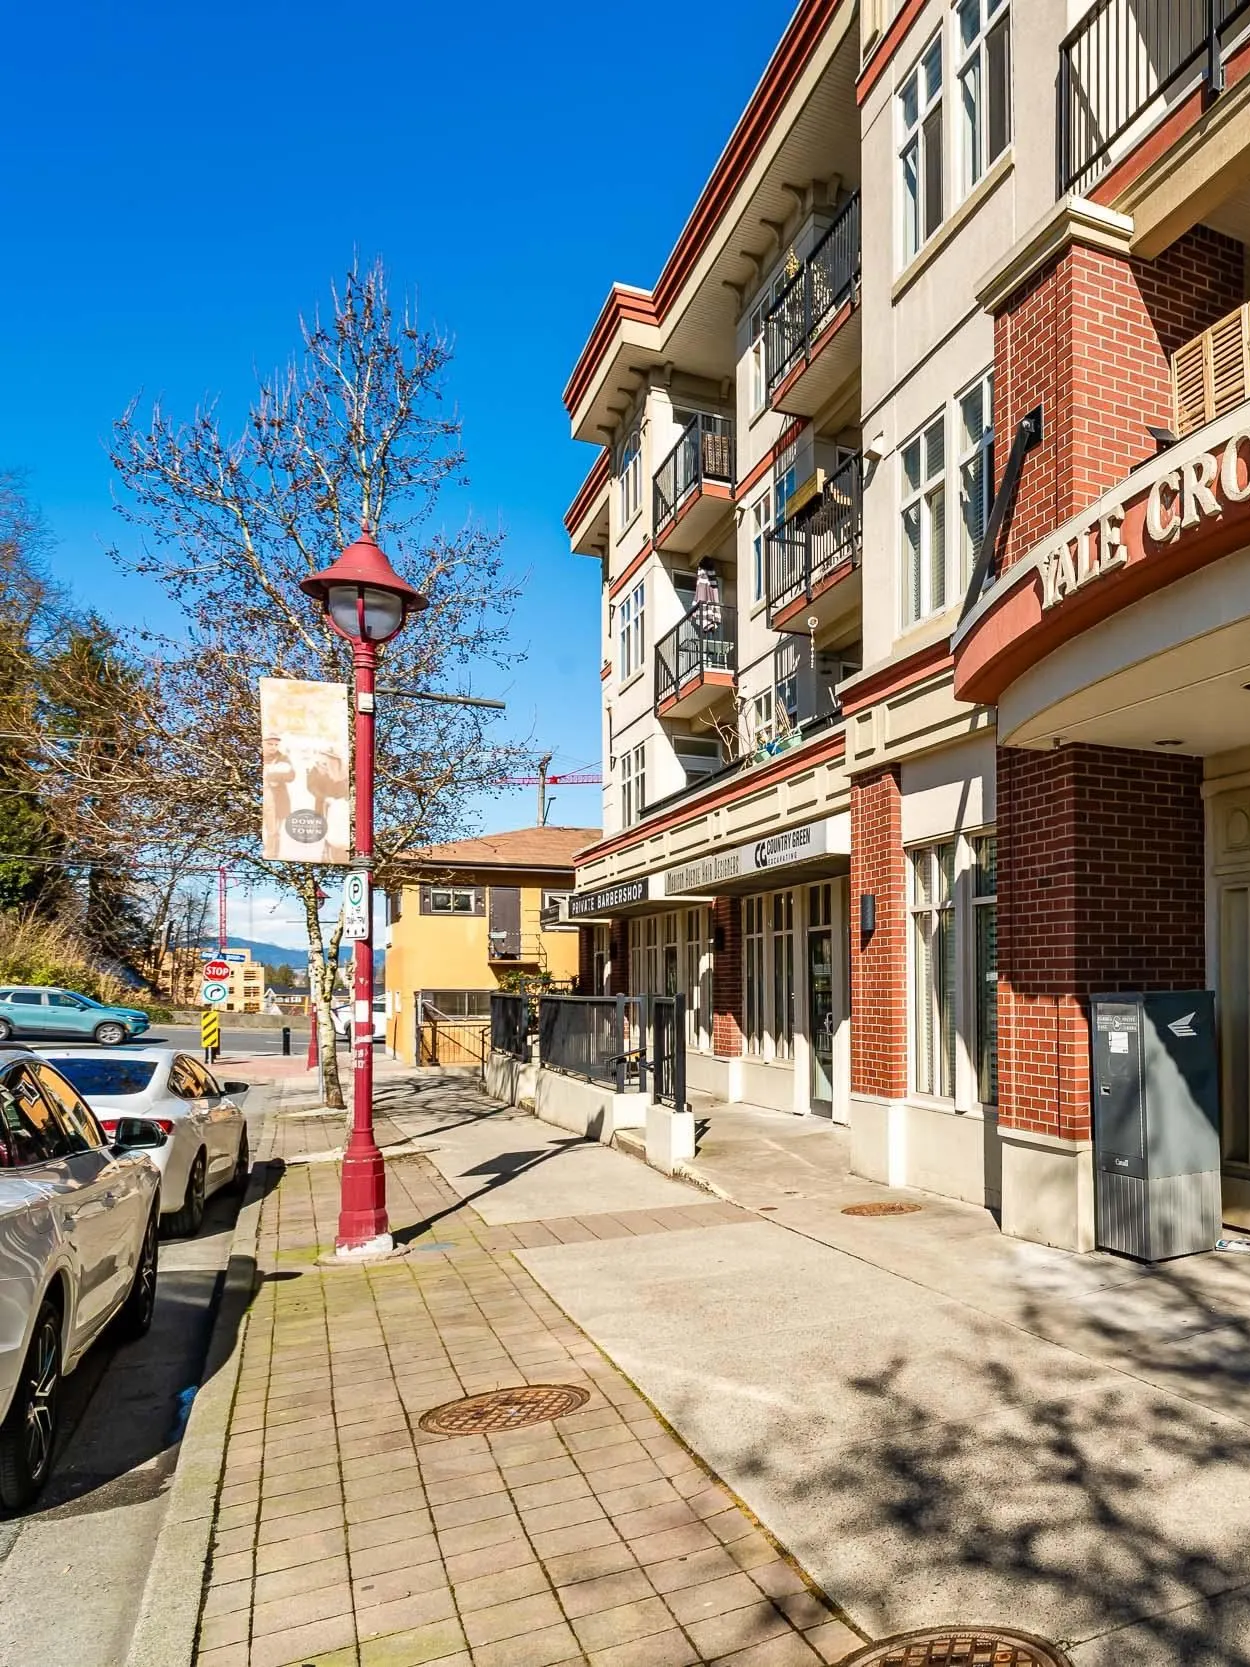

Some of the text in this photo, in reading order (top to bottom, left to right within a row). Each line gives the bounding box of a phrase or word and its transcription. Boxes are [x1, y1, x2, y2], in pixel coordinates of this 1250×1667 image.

[1035, 504, 1128, 611] YALE
[754, 841, 768, 868] CG
[766, 827, 811, 855] COUNTRY GREEN
[571, 883, 643, 915] PRIVATE BARBERSHOP
[206, 966, 229, 976] STOP
